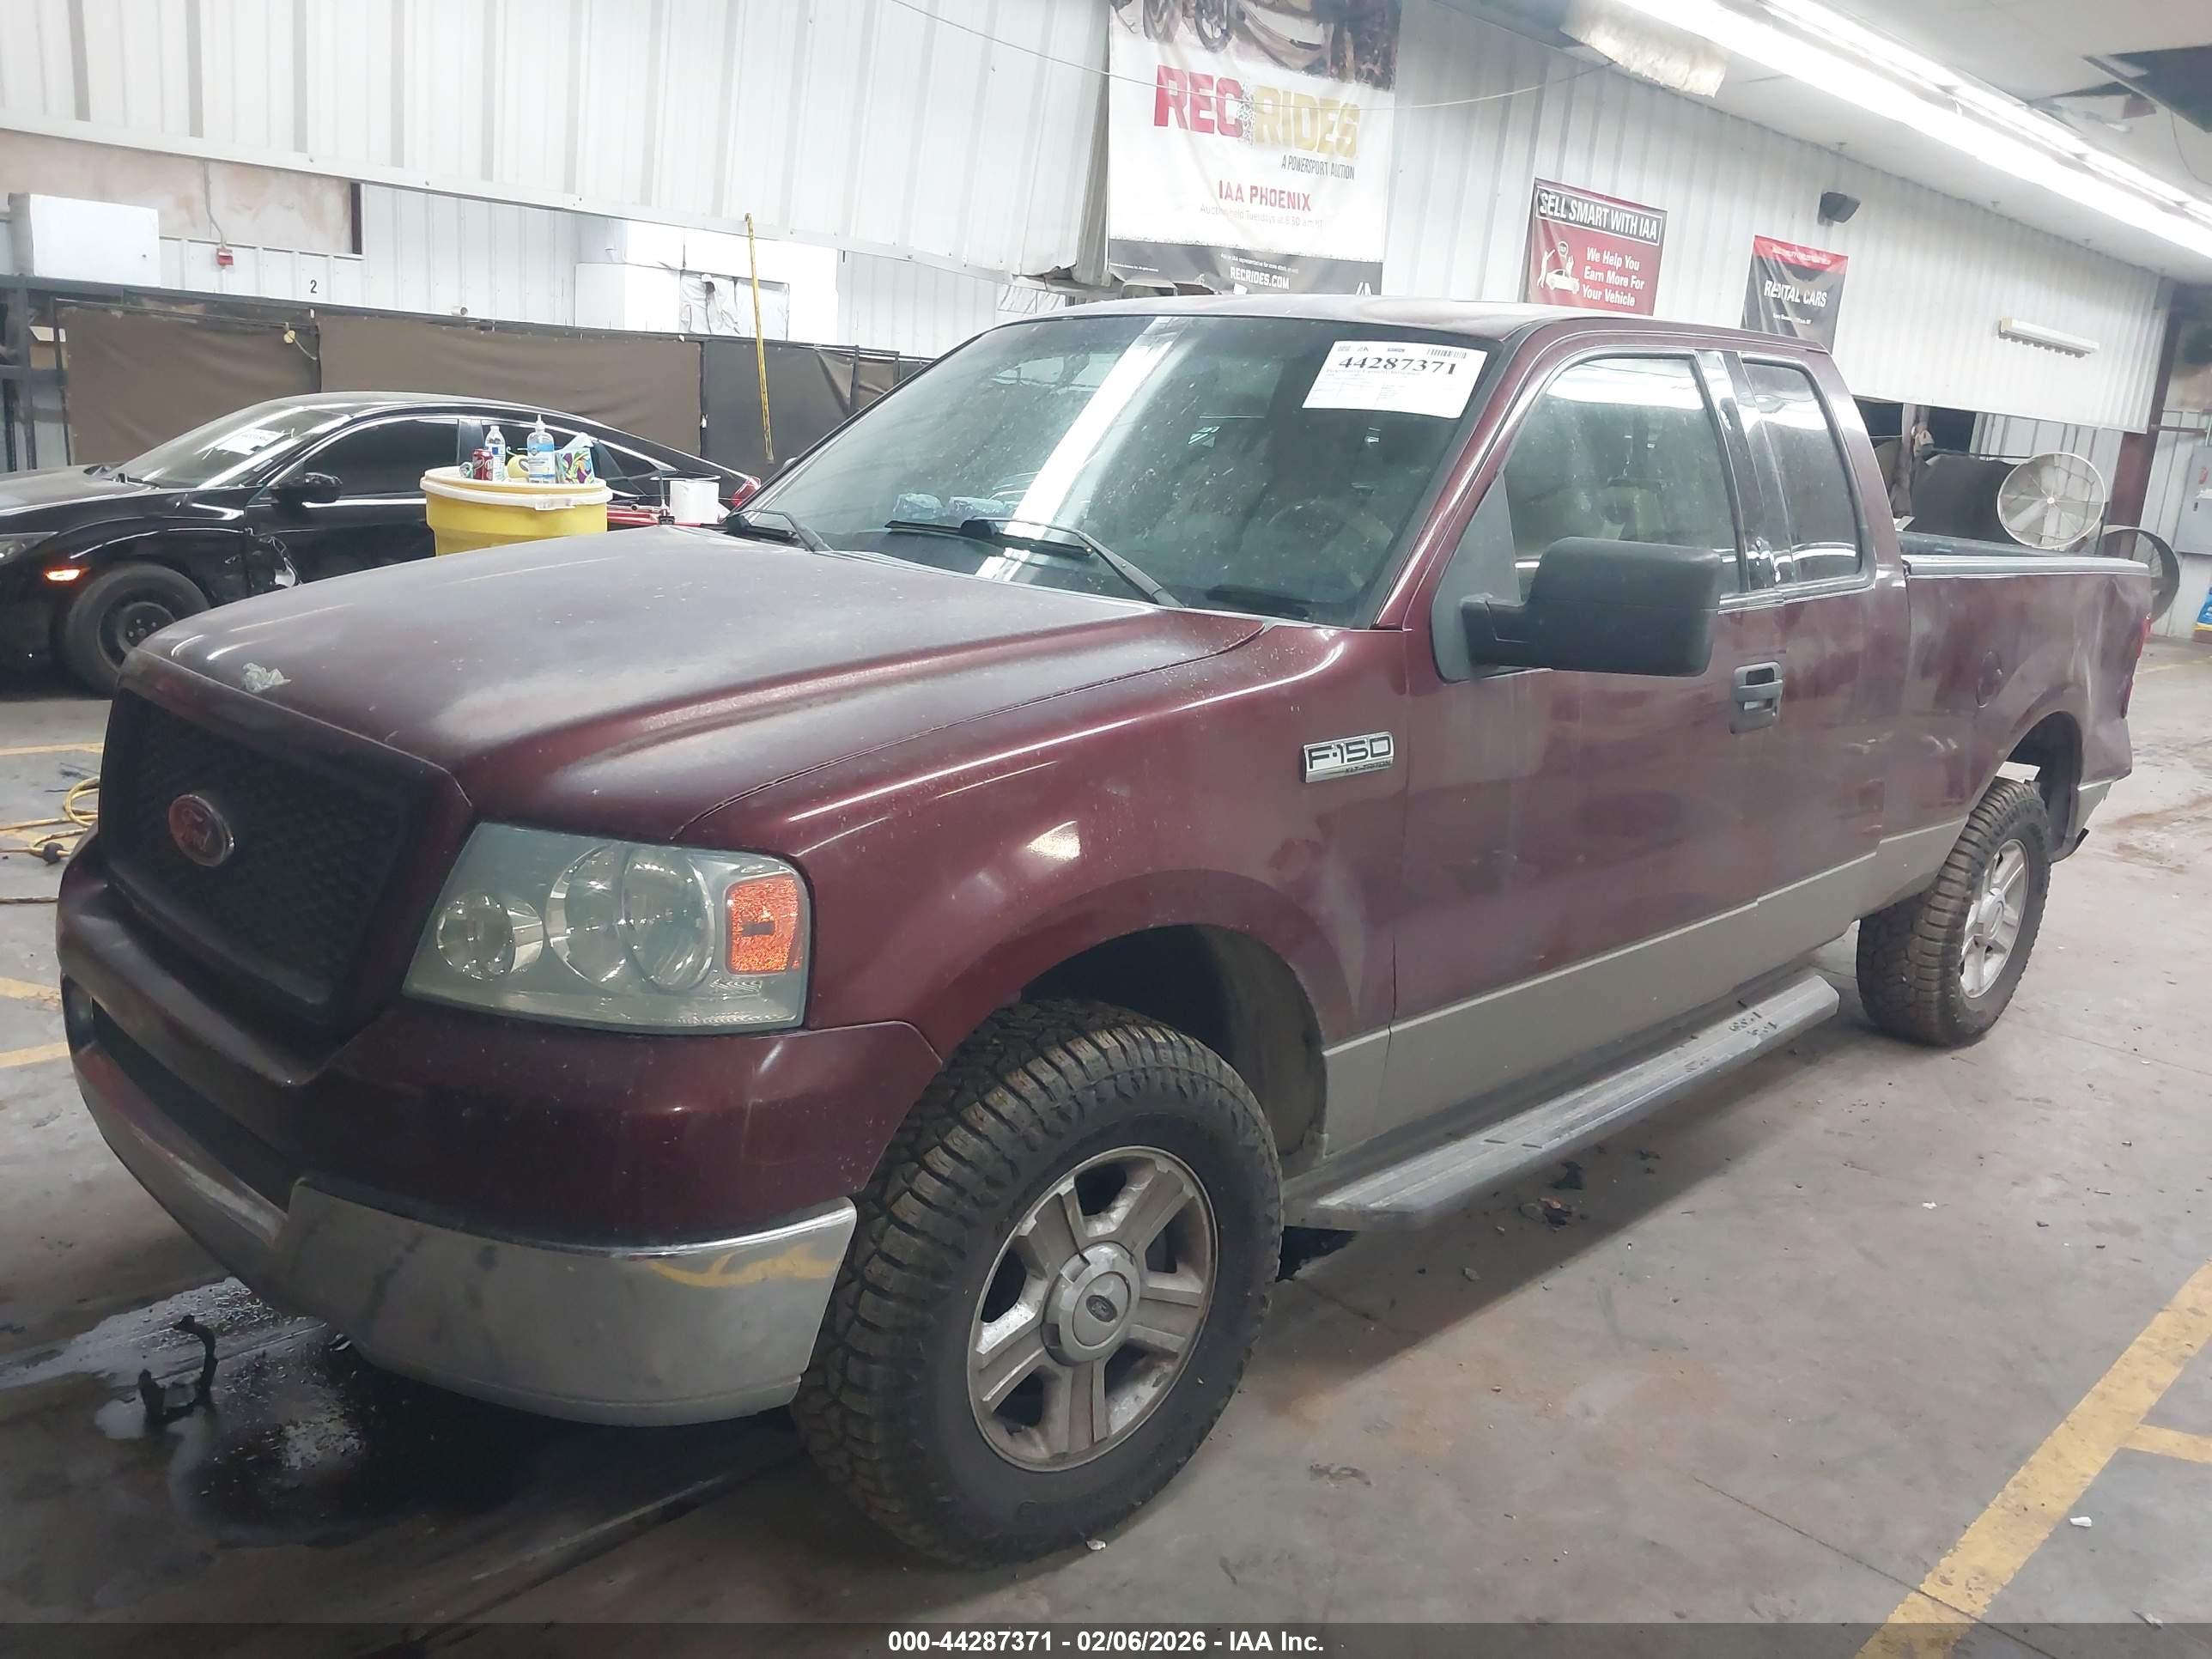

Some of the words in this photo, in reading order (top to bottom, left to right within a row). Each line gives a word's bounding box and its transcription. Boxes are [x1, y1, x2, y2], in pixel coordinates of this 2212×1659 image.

[1253, 84, 1360, 158] RIDES
[1280, 155, 1287, 169] A
[1288, 155, 1328, 177] POWERSPORT
[1330, 162, 1355, 179] AUCTION
[1218, 179, 1244, 203] IAA
[1249, 185, 1311, 211] PHOENIX
[1540, 192, 1567, 219] SELL
[1569, 199, 1609, 228] SMART
[1611, 210, 1638, 236] WITH
[1639, 216, 1657, 240] IAA
[1587, 247, 1601, 263] We
[1602, 250, 1622, 270] Help
[1625, 254, 1640, 271] You
[310, 279, 318, 294] 2
[1230, 266, 1290, 289] RECRIDES.COM
[1583, 265, 1604, 282] Earn
[1606, 270, 1629, 288] More
[1631, 275, 1645, 290] For
[1582, 283, 1602, 301] Your
[1605, 288, 1636, 307] Vehicle
[1764, 280, 1801, 303] RENTAL
[1802, 290, 1827, 307] CARS
[1339, 356, 1457, 374] 44287371
[1308, 736, 1392, 769] F-150
